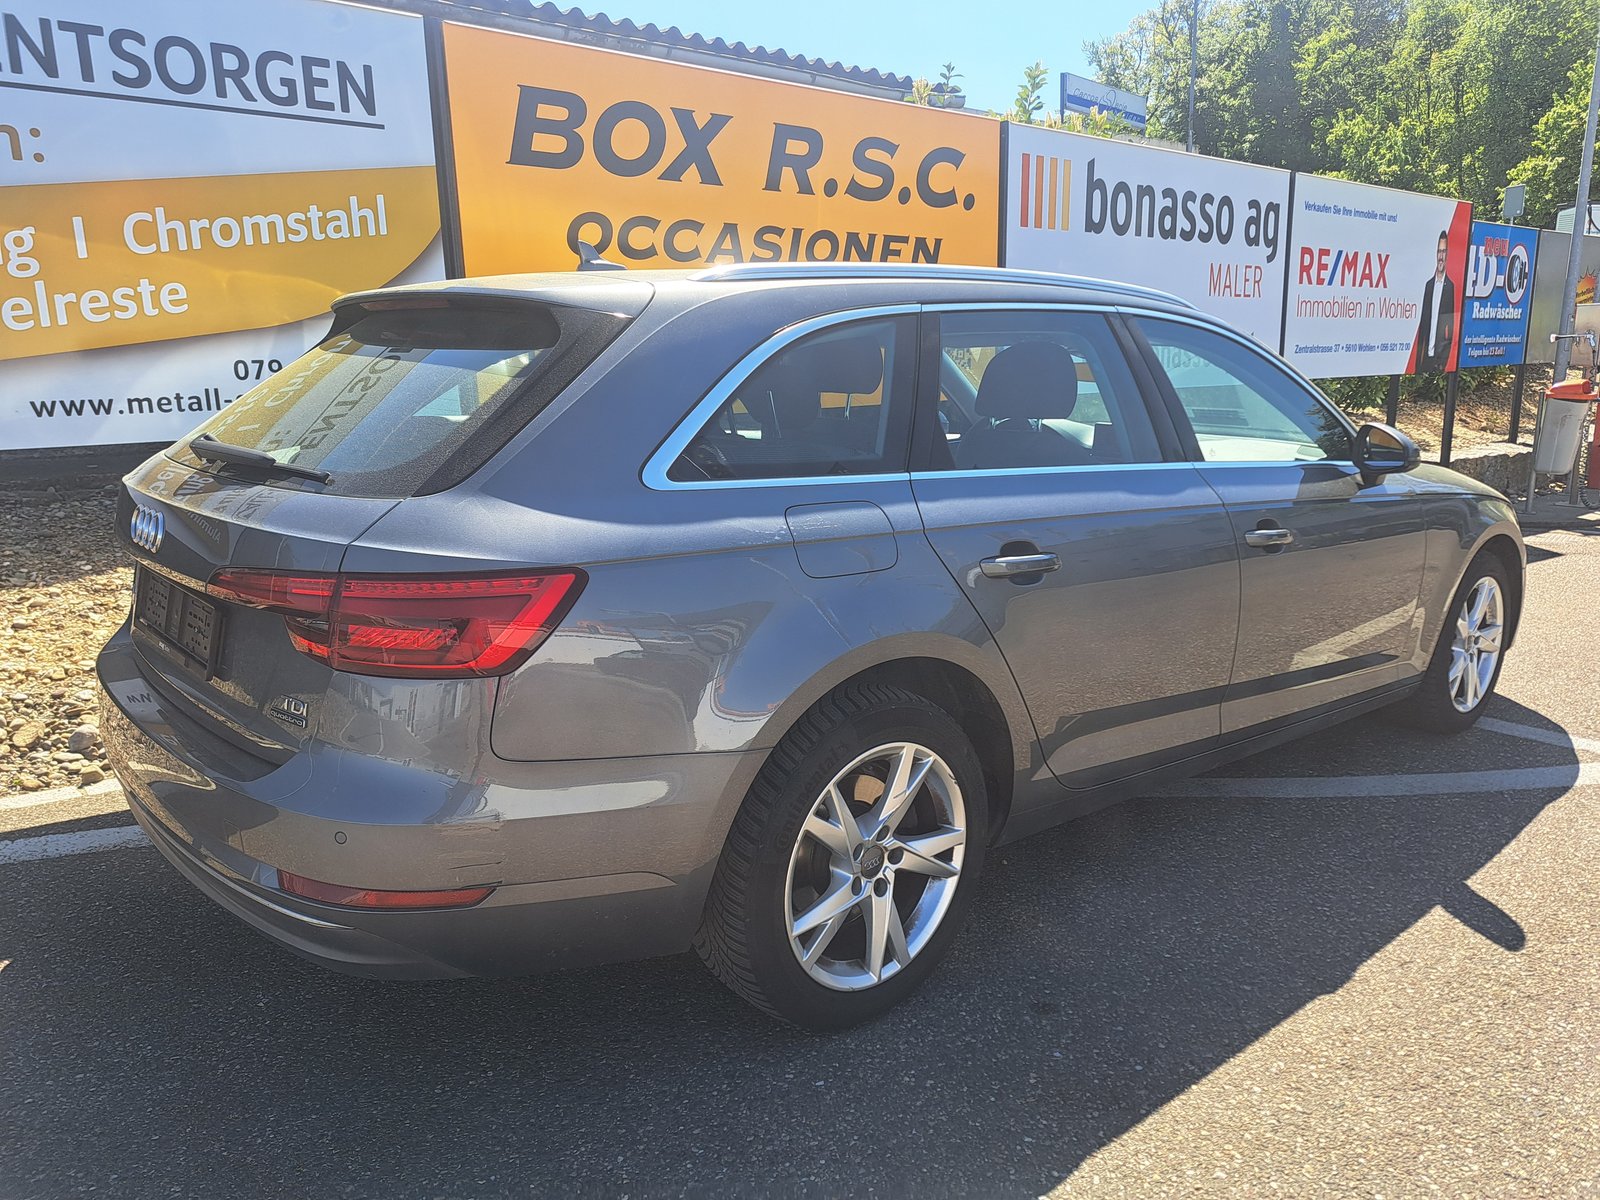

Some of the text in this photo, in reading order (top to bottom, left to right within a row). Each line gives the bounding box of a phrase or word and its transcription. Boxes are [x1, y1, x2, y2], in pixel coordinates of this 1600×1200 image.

[0, 12, 378, 117] NTSORGEN
[505, 84, 976, 212] BOX R.S.C.
[1084, 157, 1281, 264] bonasso ag
[1304, 200, 1398, 223] Verkaufen Sie Ihre Immobilie mit uns!
[0, 226, 40, 278] g
[123, 194, 388, 255] Chromstahl
[566, 211, 942, 264] OCCASIONEN
[1484, 237, 1509, 256] neu
[1208, 262, 1263, 298] MALER
[1298, 246, 1391, 288] RE/MAX
[1, 278, 189, 331] elreste
[1296, 294, 1417, 319] Immobilien in Wohlen
[1472, 302, 1522, 319] Radwäscher
[1294, 344, 1333, 354] Zentralstrasse
[1334, 343, 1341, 353] 37
[1345, 343, 1357, 352] 5610
[1358, 343, 1376, 352] Wohlen
[1380, 343, 1389, 352] 056
[233, 359, 283, 381] 079
[270, 710, 303, 727] quattro
[280, 697, 308, 718] TDI
